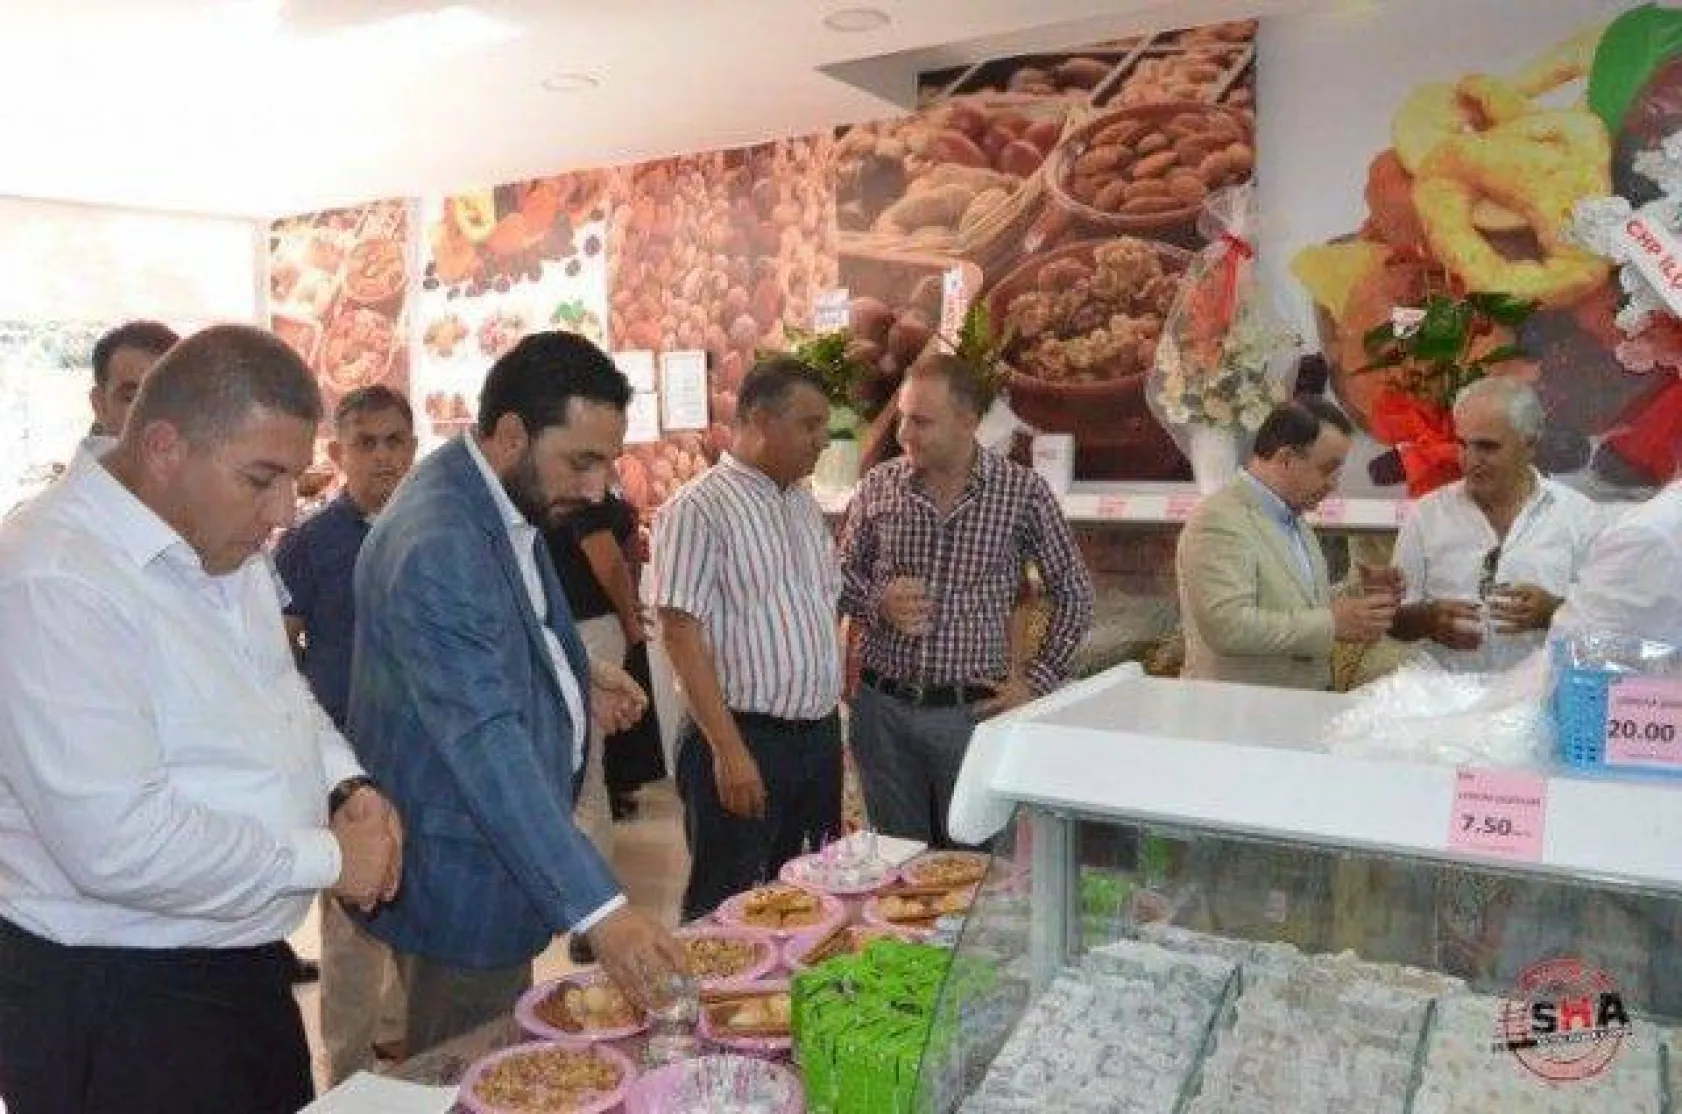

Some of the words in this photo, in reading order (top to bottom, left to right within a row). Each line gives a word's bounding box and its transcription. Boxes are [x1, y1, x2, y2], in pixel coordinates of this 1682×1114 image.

[1626, 220, 1662, 255] CHP
[1608, 719, 1675, 742] 20.00
[1461, 814, 1512, 835] 7.50
